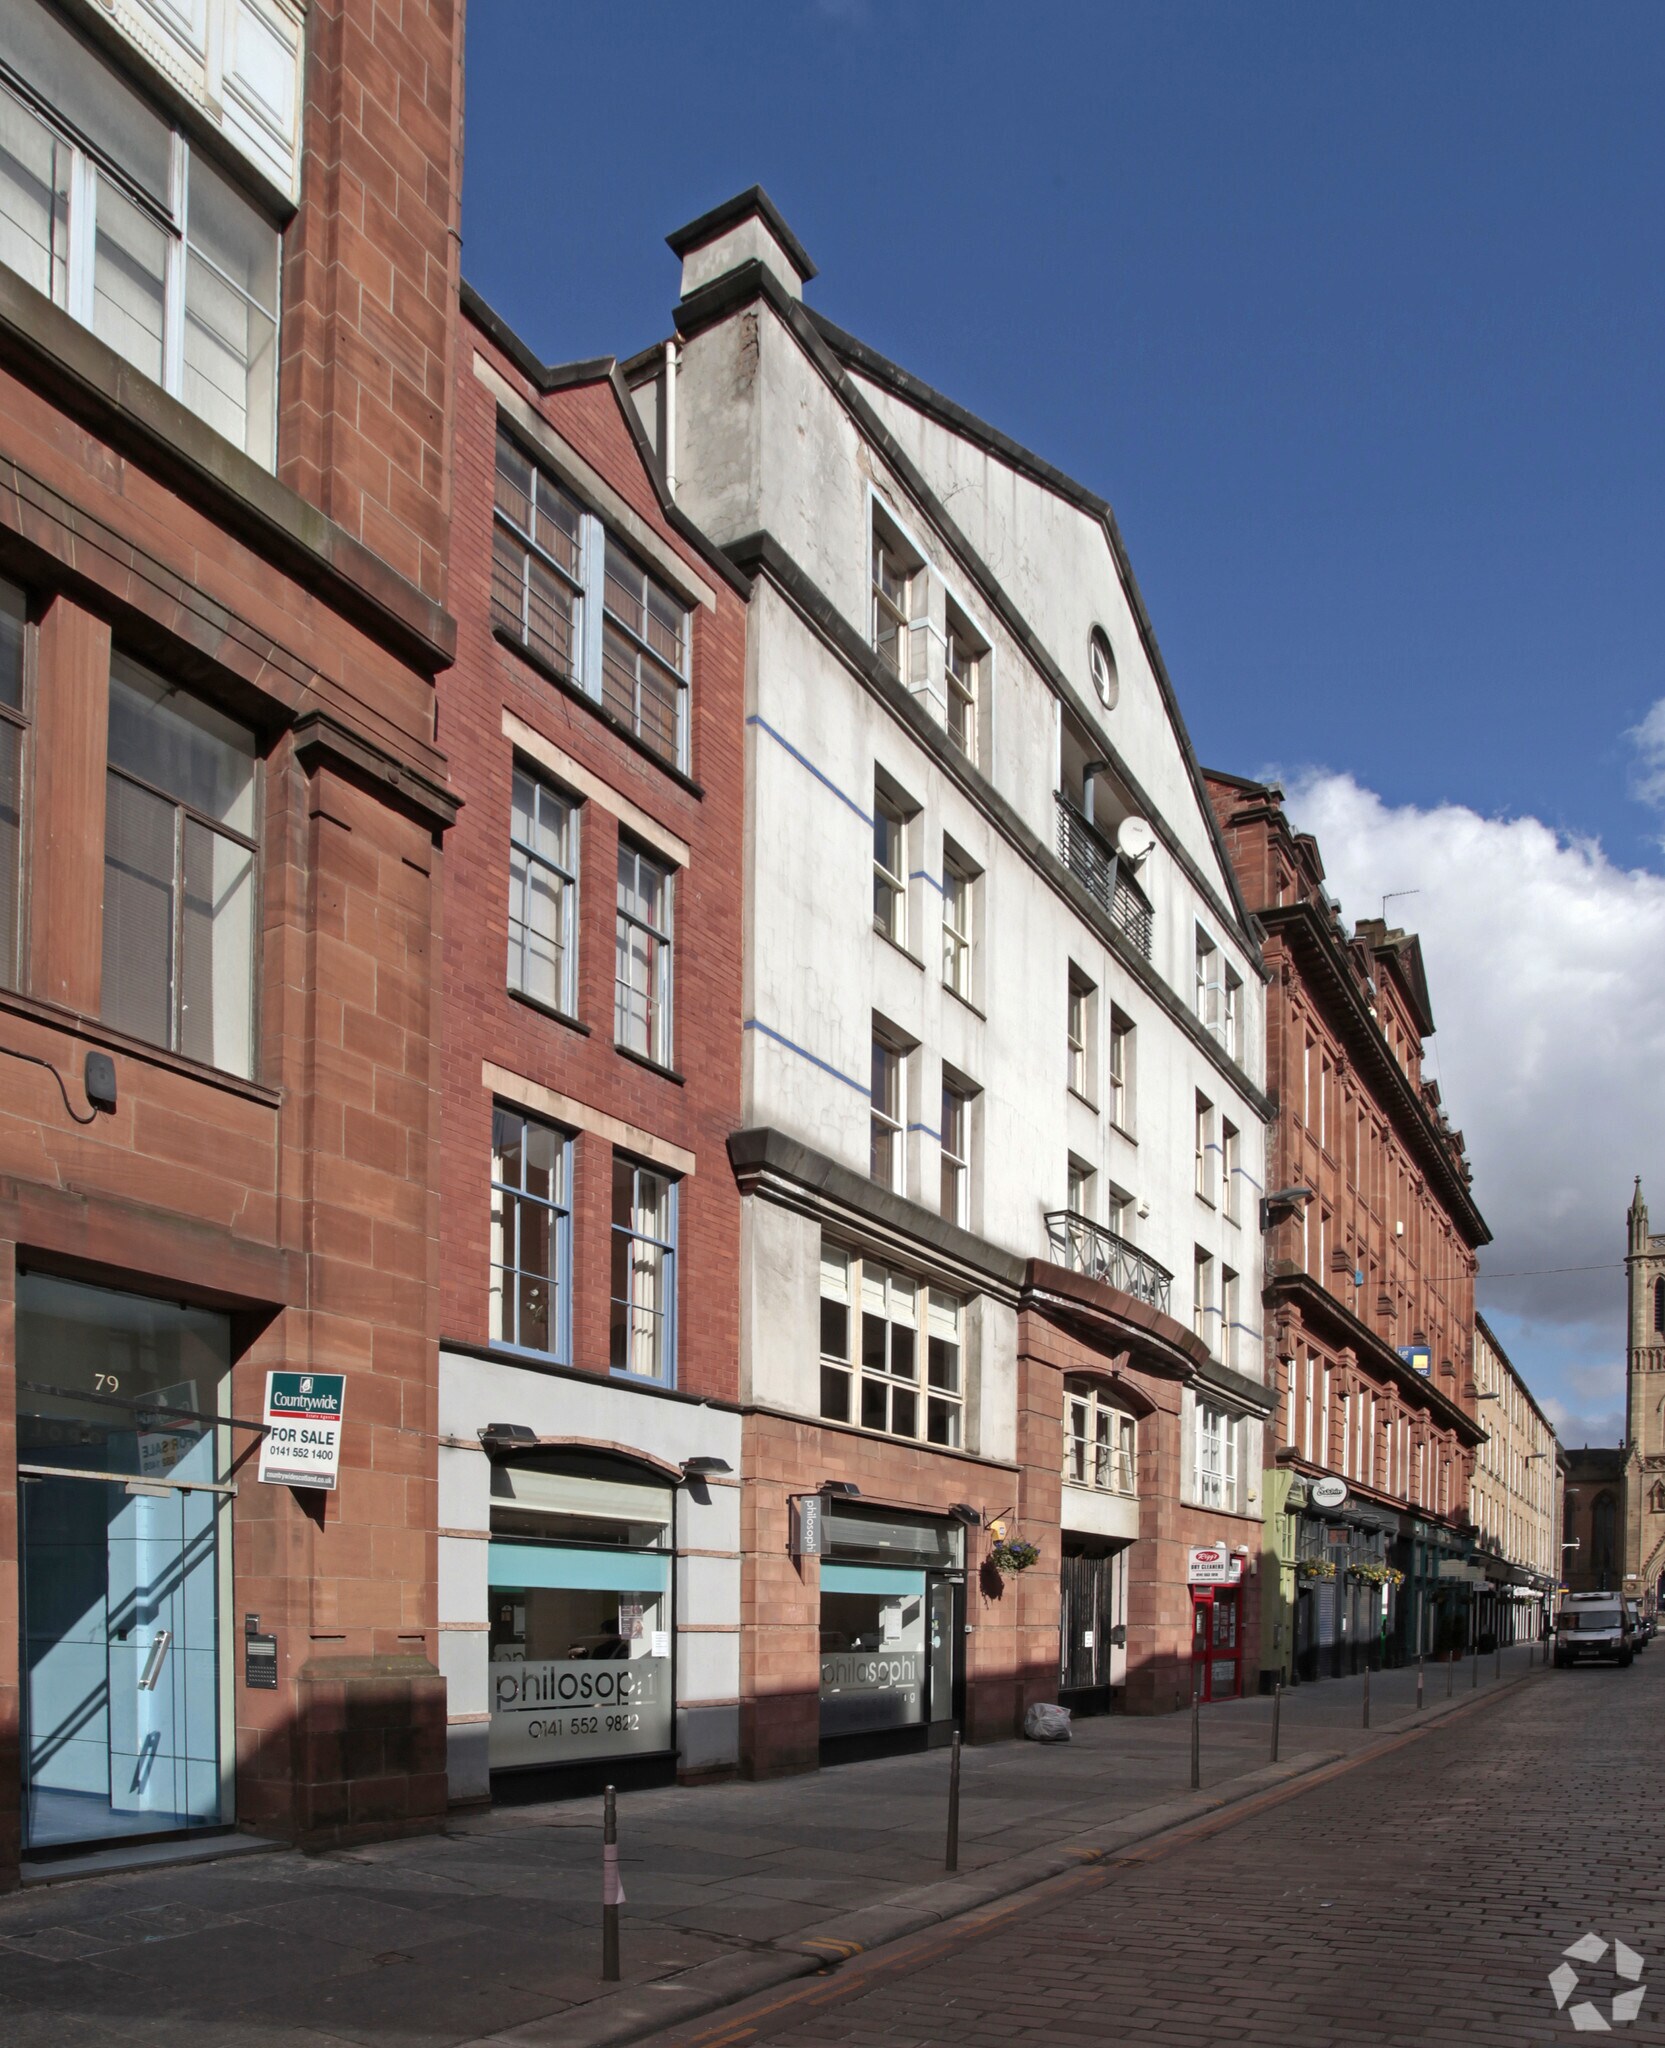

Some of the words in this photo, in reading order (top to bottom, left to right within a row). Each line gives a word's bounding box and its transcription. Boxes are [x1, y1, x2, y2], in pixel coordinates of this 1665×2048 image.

[94, 1373, 120, 1393] 79
[273, 1391, 338, 1411] Countrywide
[271, 1427, 297, 1442] FOR
[300, 1429, 335, 1446] SALE
[270, 1445, 291, 1456] 0141
[292, 1447, 310, 1459] 552
[311, 1449, 334, 1461] 1400
[265, 1471, 333, 1484] countrywidescotland.co.uk
[804, 1500, 817, 1553] philosophi
[822, 1654, 916, 1692] philosophi
[496, 1662, 660, 1713] philosop
[528, 1719, 563, 1739] 0141
[570, 1716, 598, 1735] 552
[605, 1713, 640, 1732] 9822
